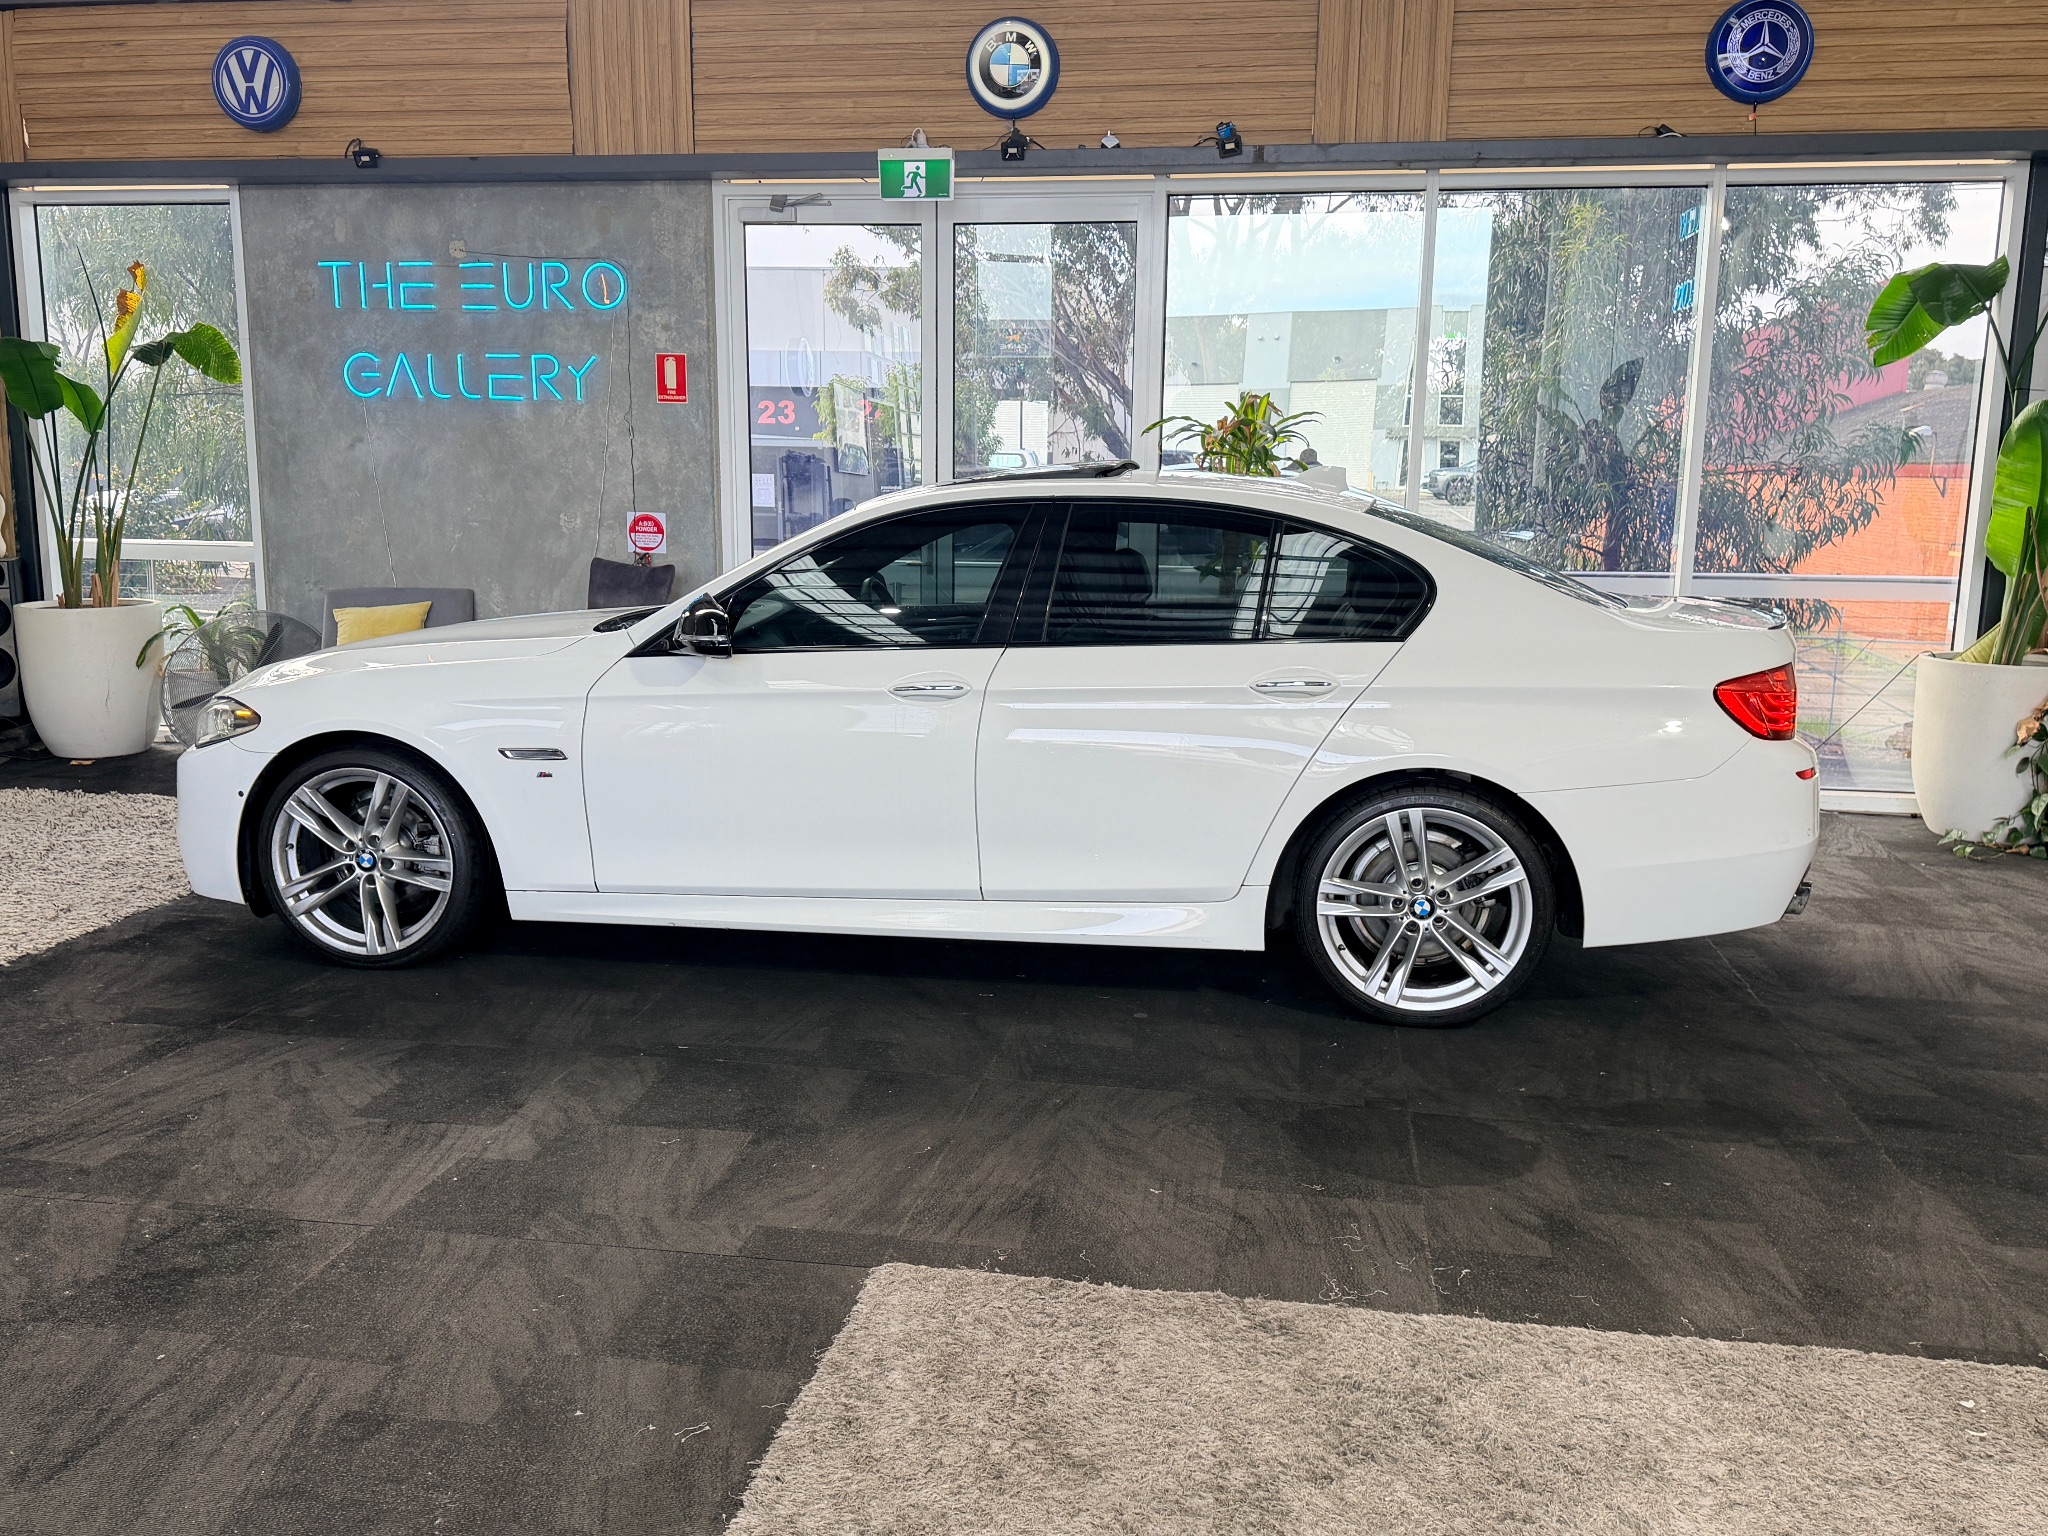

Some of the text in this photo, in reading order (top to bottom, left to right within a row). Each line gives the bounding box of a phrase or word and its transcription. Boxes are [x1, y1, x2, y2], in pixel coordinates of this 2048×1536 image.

[1741, 11, 1791, 29] MERCEDES
[986, 32, 1037, 53] BMW
[1747, 69, 1775, 80] BENZ
[317, 260, 626, 310] THE EURO
[343, 352, 597, 401] GALLERY
[757, 400, 796, 425] 23
[635, 525, 658, 533] POWDER
